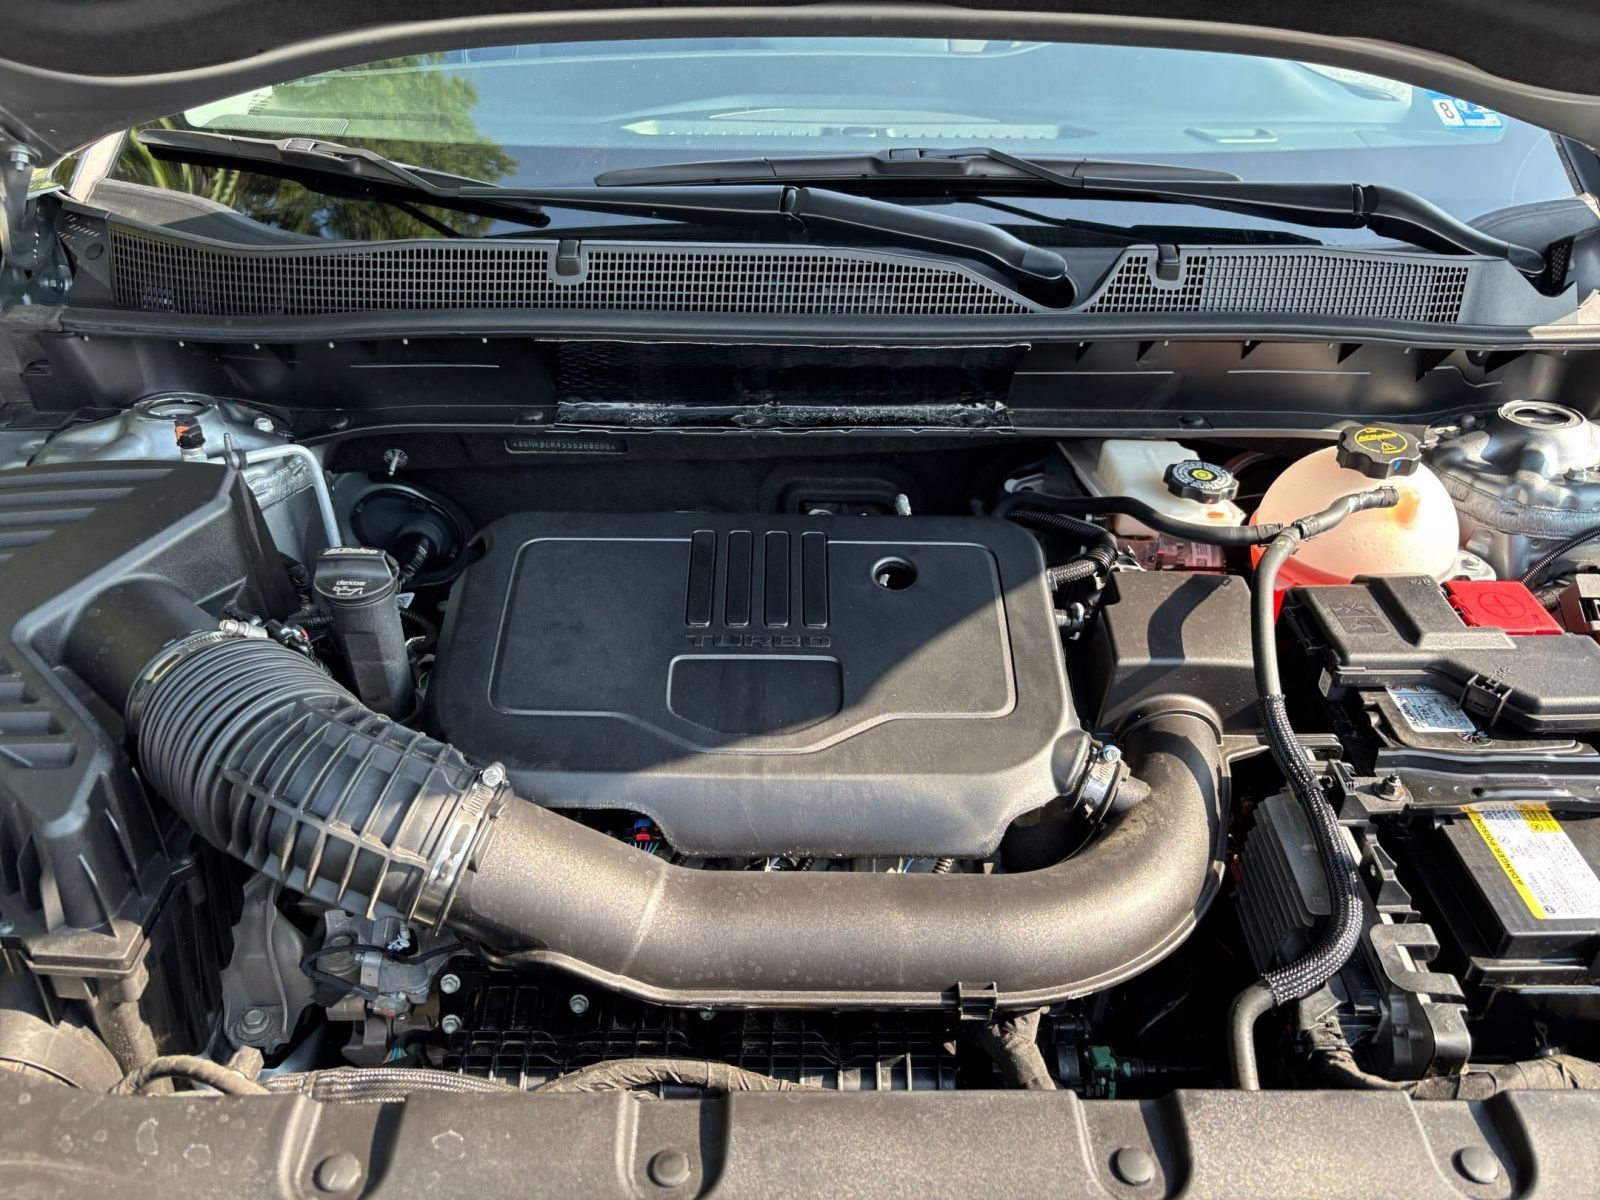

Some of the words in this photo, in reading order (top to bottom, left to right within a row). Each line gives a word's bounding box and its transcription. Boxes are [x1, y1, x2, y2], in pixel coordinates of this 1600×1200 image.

[1439, 101, 1455, 119] 8
[685, 634, 832, 648] TURBO
[1476, 817, 1497, 847] POISON
[1495, 846, 1520, 881] DANGER
